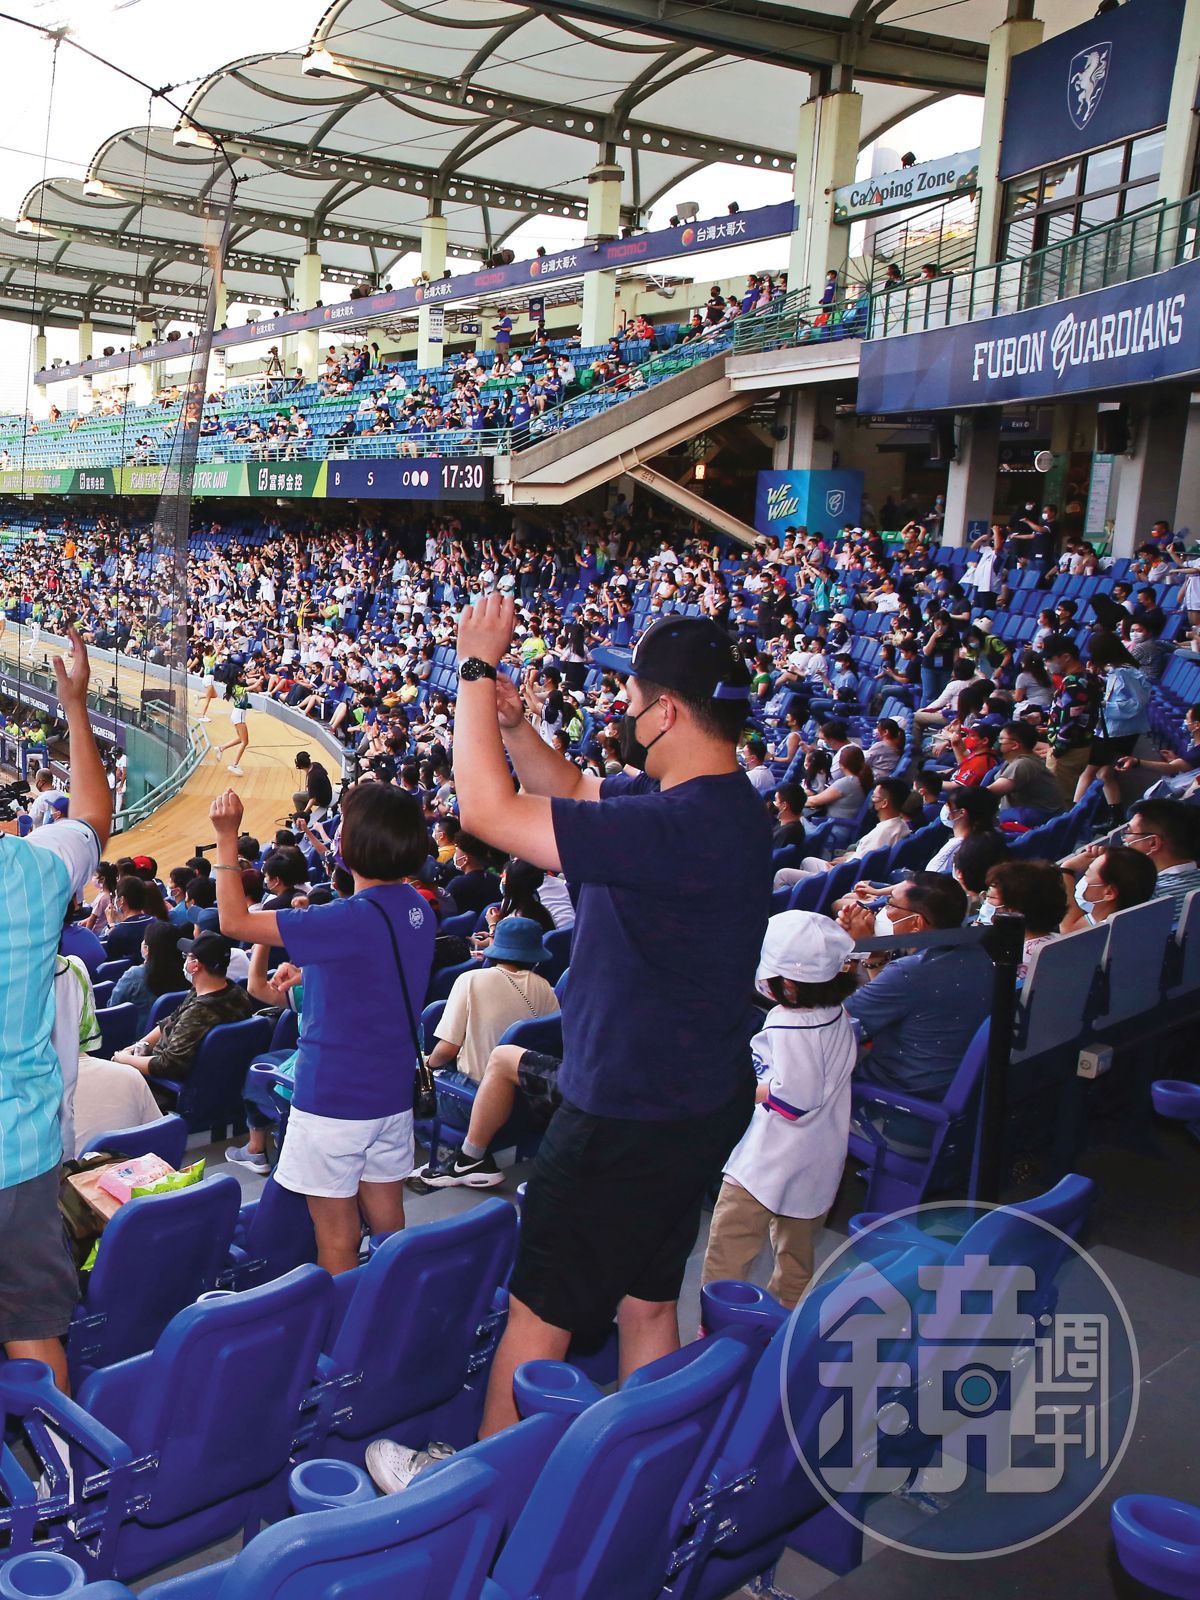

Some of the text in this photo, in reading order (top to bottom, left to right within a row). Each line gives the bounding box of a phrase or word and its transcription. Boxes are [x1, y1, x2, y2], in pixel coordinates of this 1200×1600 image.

[918, 169, 955, 197] Zone
[696, 220, 746, 243] 台灣大哥大
[541, 255, 577, 275] 台灣大哥大
[423, 282, 452, 300] 台灣大哥大
[972, 294, 1185, 382] FUBON GUARDIANS
[198, 472, 212, 489] FOR
[213, 471, 229, 489] WIN
[269, 473, 303, 491] 富邦金控
[335, 472, 340, 485] B
[367, 472, 373, 486] S
[441, 464, 483, 489] 17:30
[767, 484, 792, 505] WE
[768, 496, 799, 521] WILL
